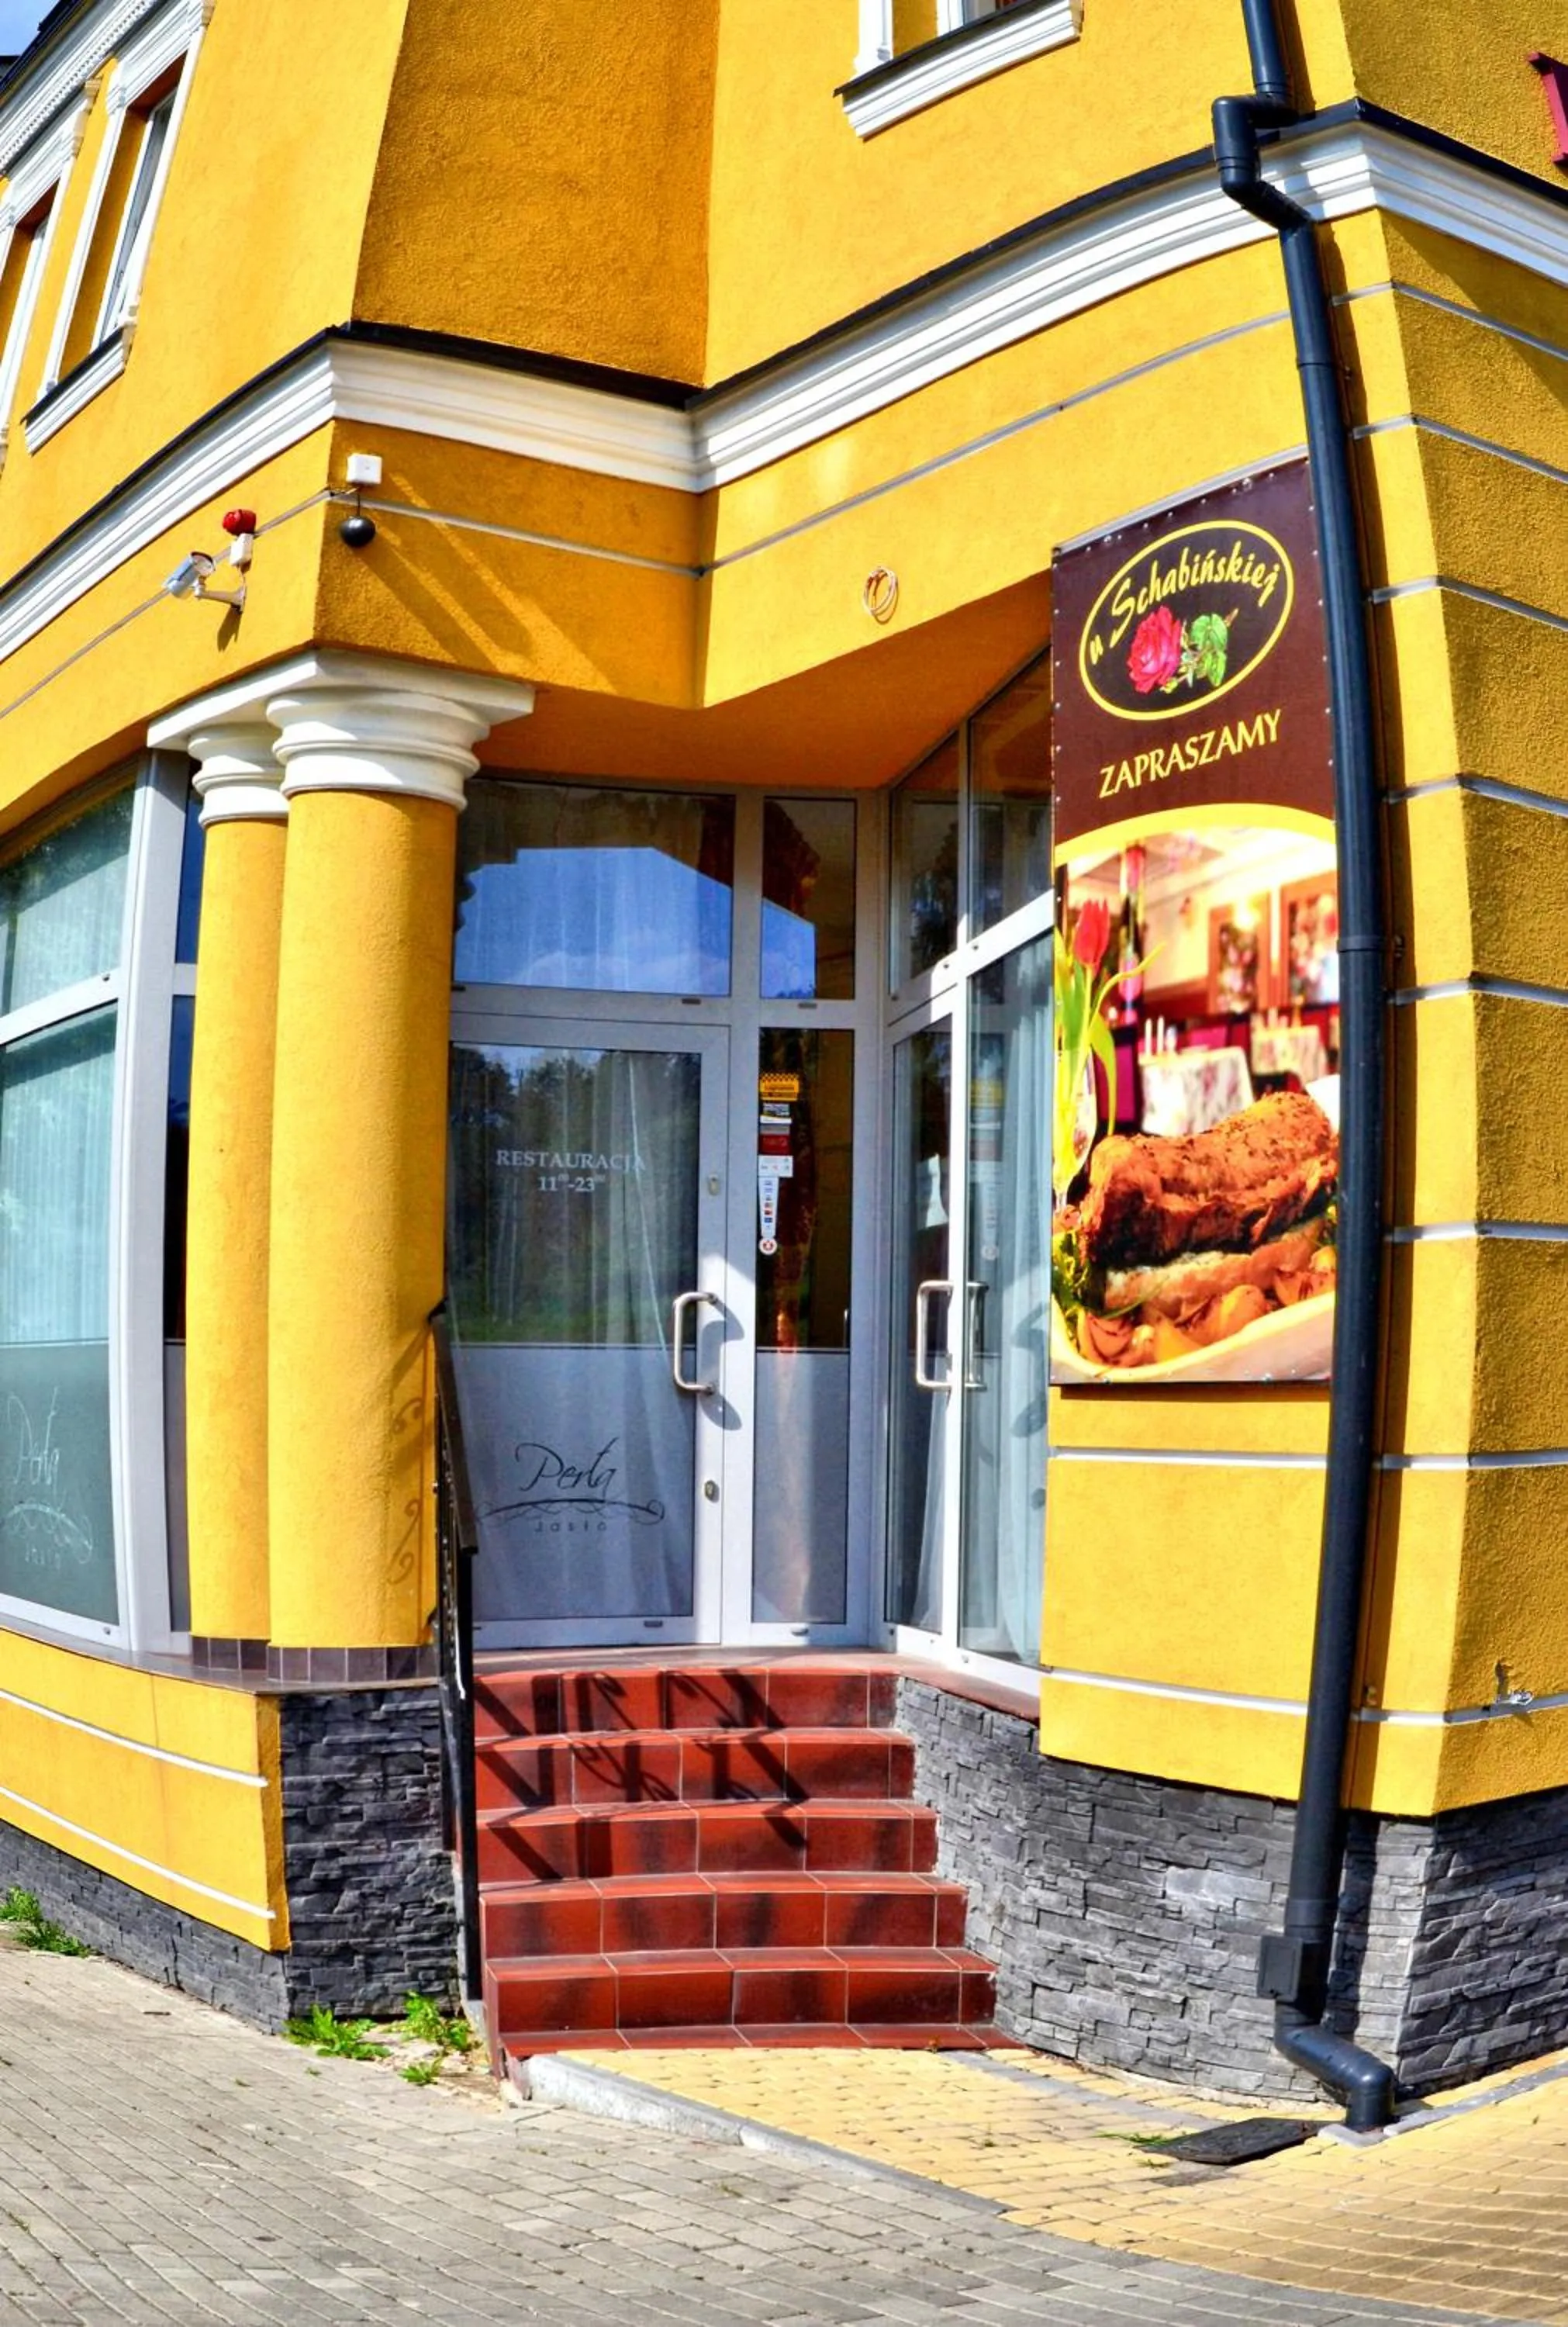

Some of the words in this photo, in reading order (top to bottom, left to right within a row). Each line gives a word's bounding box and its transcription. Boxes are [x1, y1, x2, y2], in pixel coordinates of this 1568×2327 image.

[1109, 541, 1280, 648] Schabińskiej
[1099, 708, 1281, 800] ZAPRASZAMY
[496, 1149, 646, 1173] RESTAURACJA
